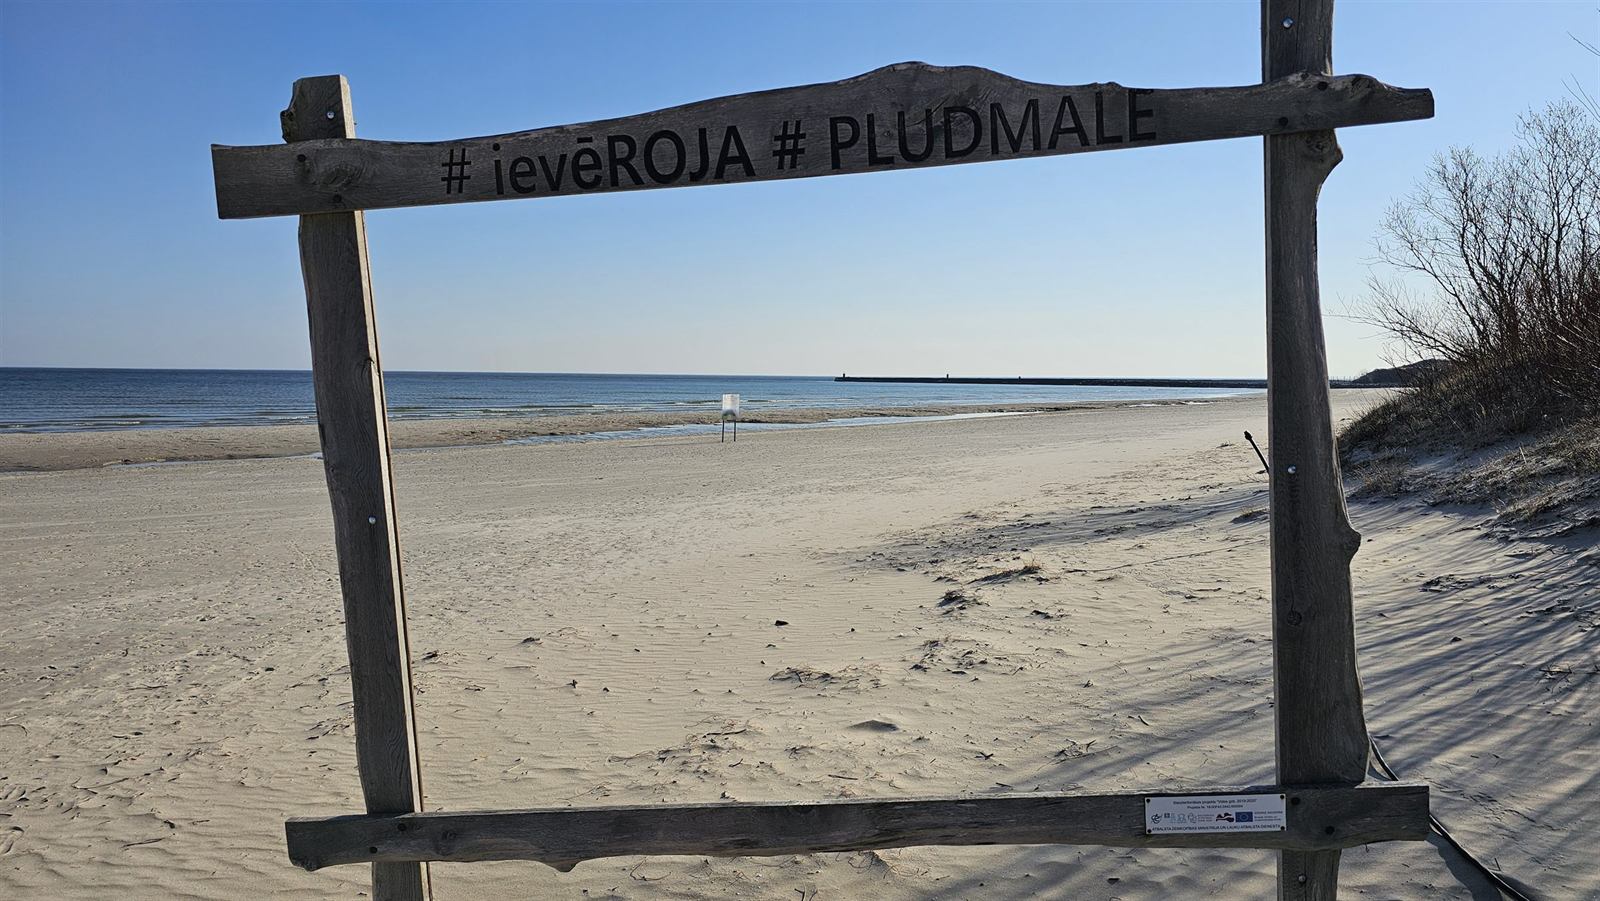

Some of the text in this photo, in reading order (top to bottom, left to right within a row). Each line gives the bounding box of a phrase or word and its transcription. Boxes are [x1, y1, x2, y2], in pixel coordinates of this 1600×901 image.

[441, 88, 1157, 195] # ievēROJA # PLUDMALE
